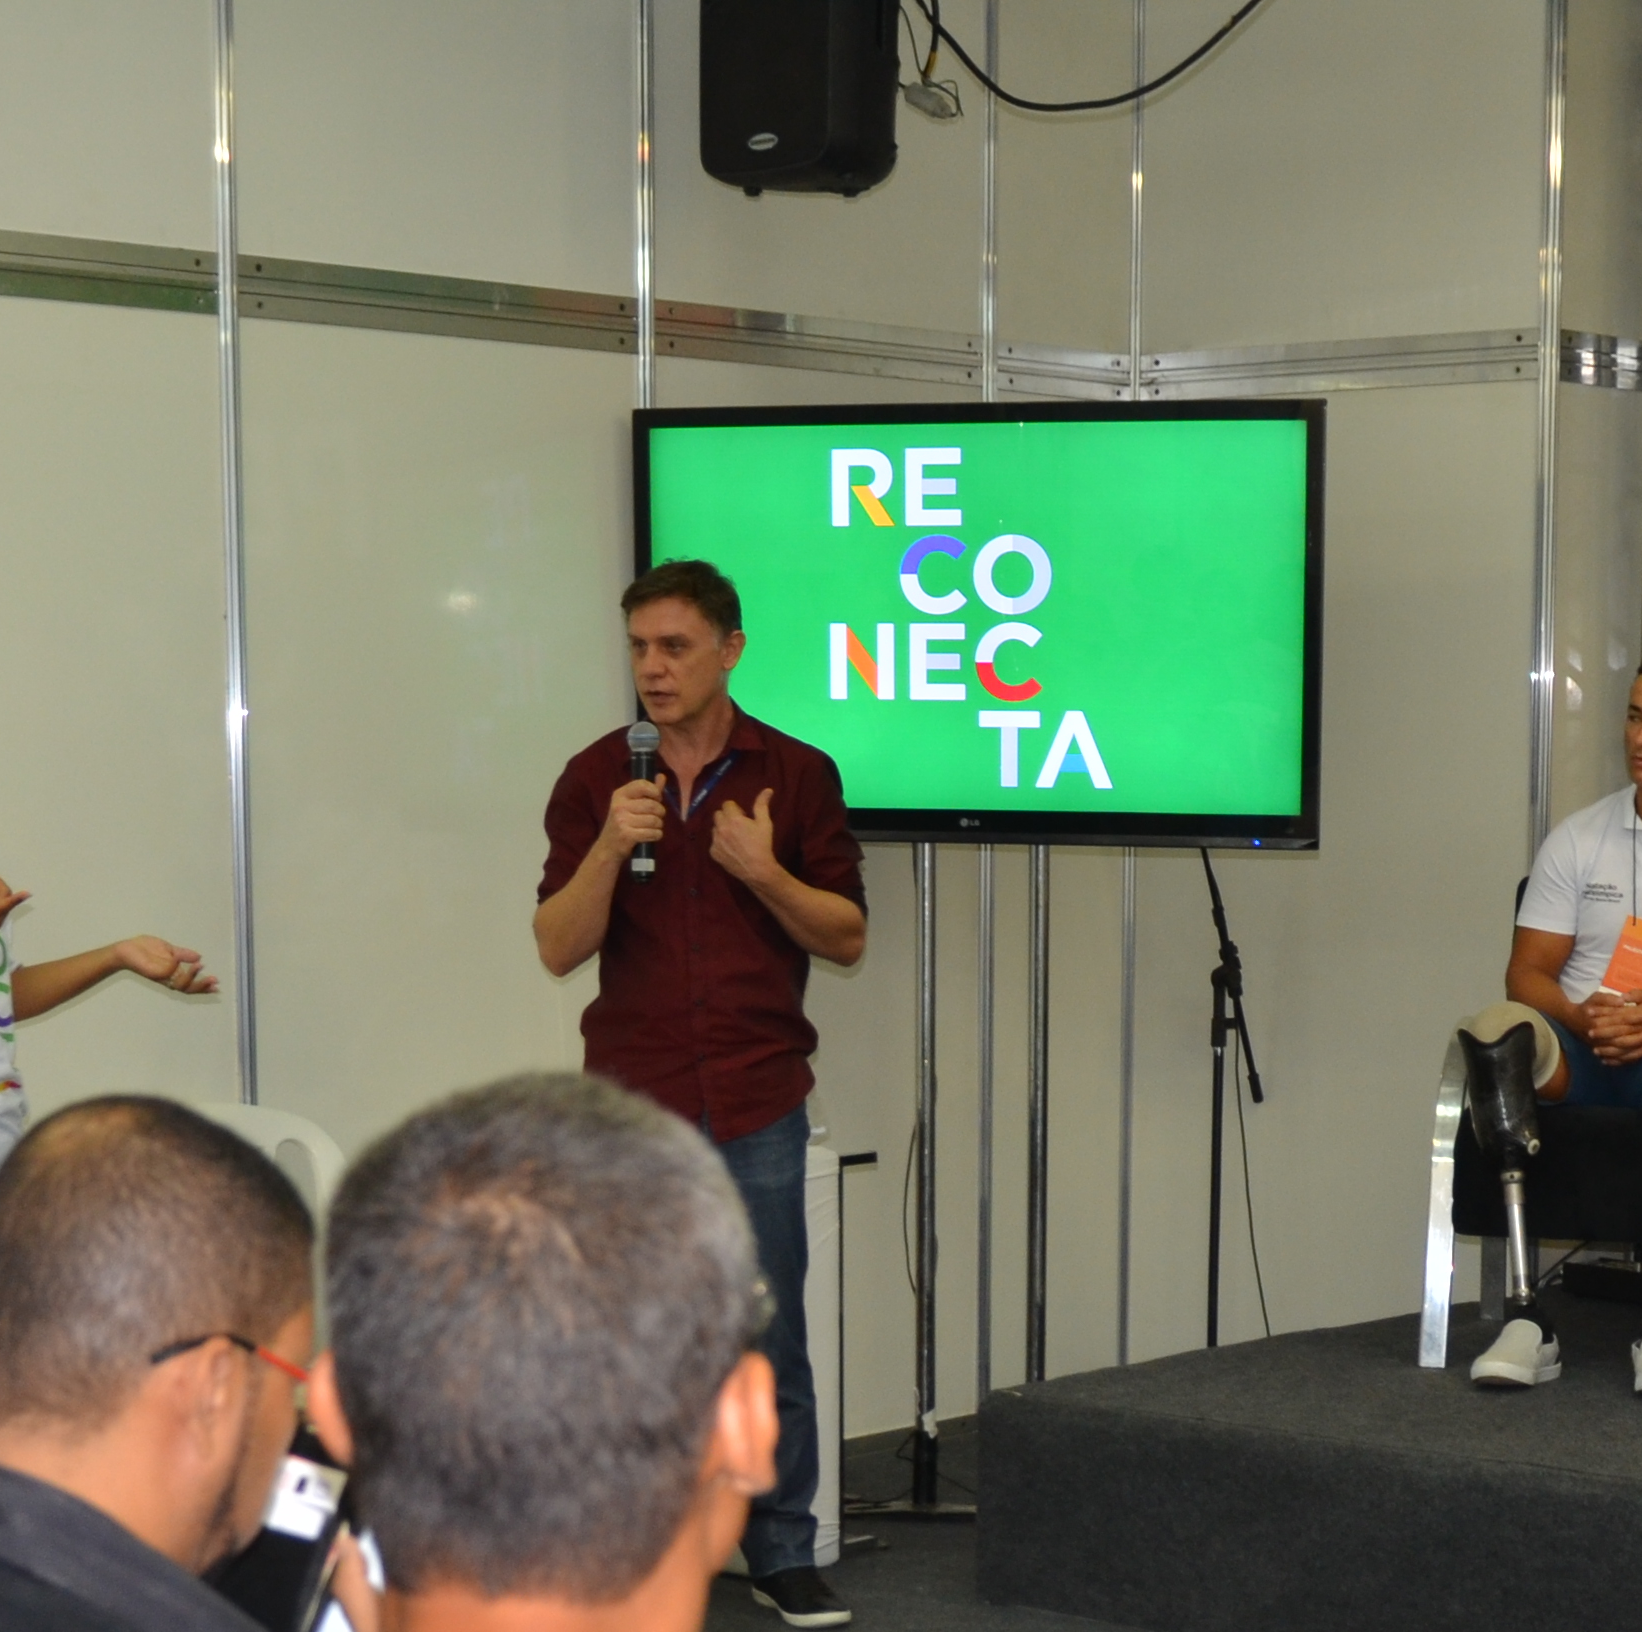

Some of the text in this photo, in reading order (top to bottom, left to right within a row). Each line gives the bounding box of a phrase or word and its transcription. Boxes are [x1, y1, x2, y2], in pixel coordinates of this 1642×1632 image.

[831, 446, 963, 528] RE
[899, 534, 1054, 616] CO
[828, 621, 1044, 701] NEC
[978, 709, 1114, 790] TA
